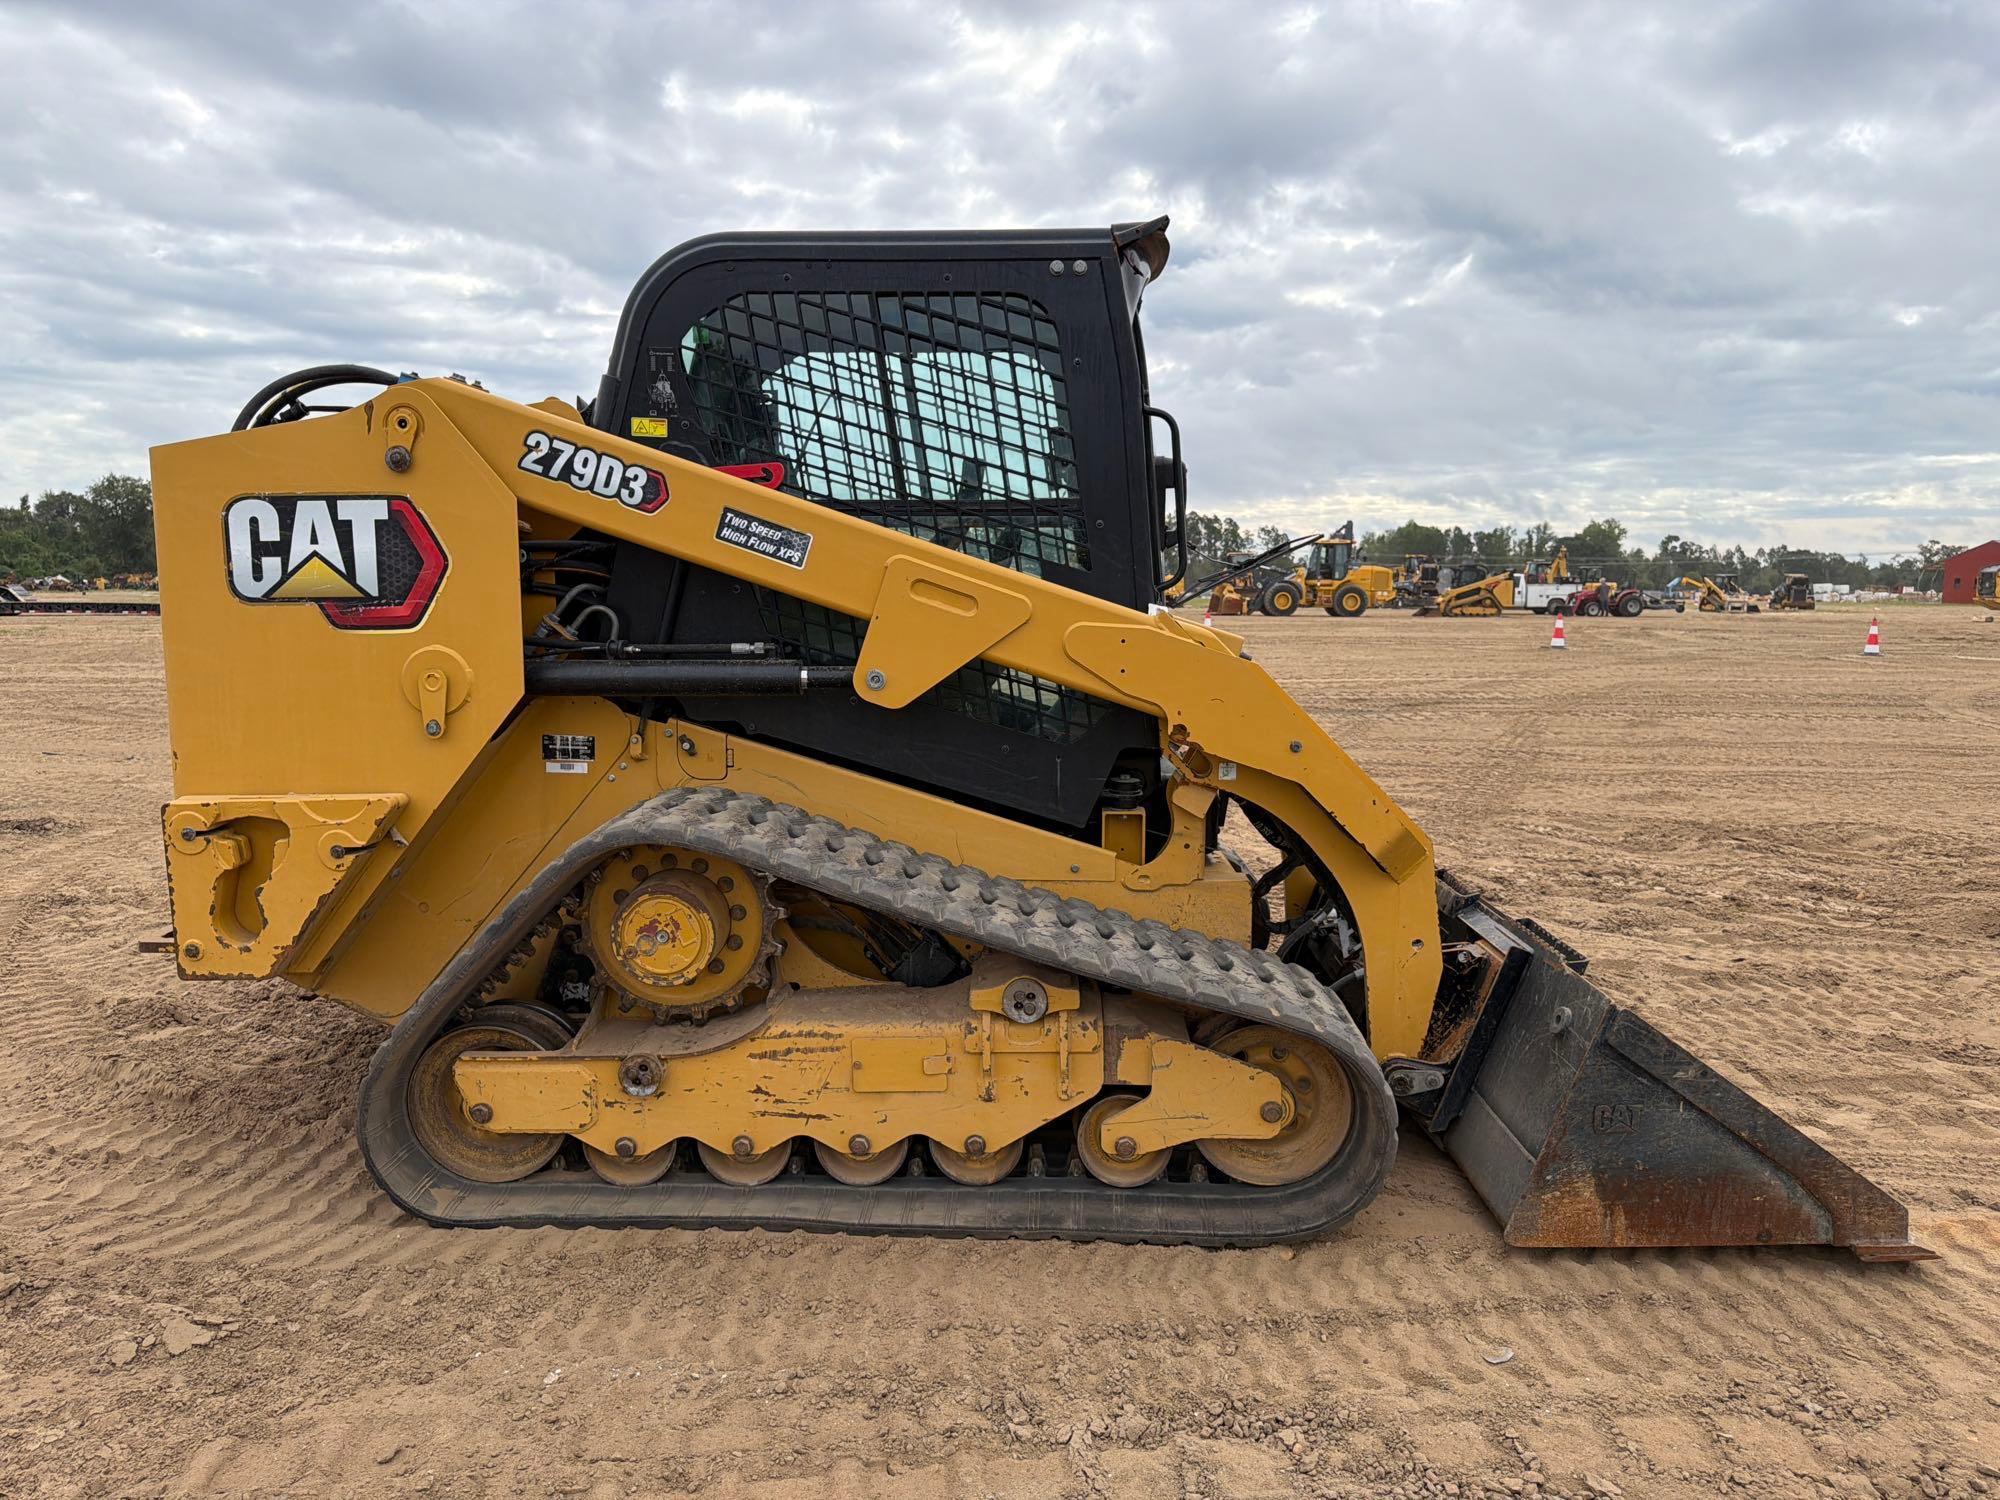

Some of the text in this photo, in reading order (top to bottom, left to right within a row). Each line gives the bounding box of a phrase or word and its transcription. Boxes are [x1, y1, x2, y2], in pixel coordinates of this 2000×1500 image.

[520, 432, 648, 506] 279D3
[724, 512, 782, 541] TWO SPEED
[228, 499, 389, 598] CAT
[720, 527, 802, 563] HIGH FLOW XPS
[1594, 1105, 1643, 1133] CAT
